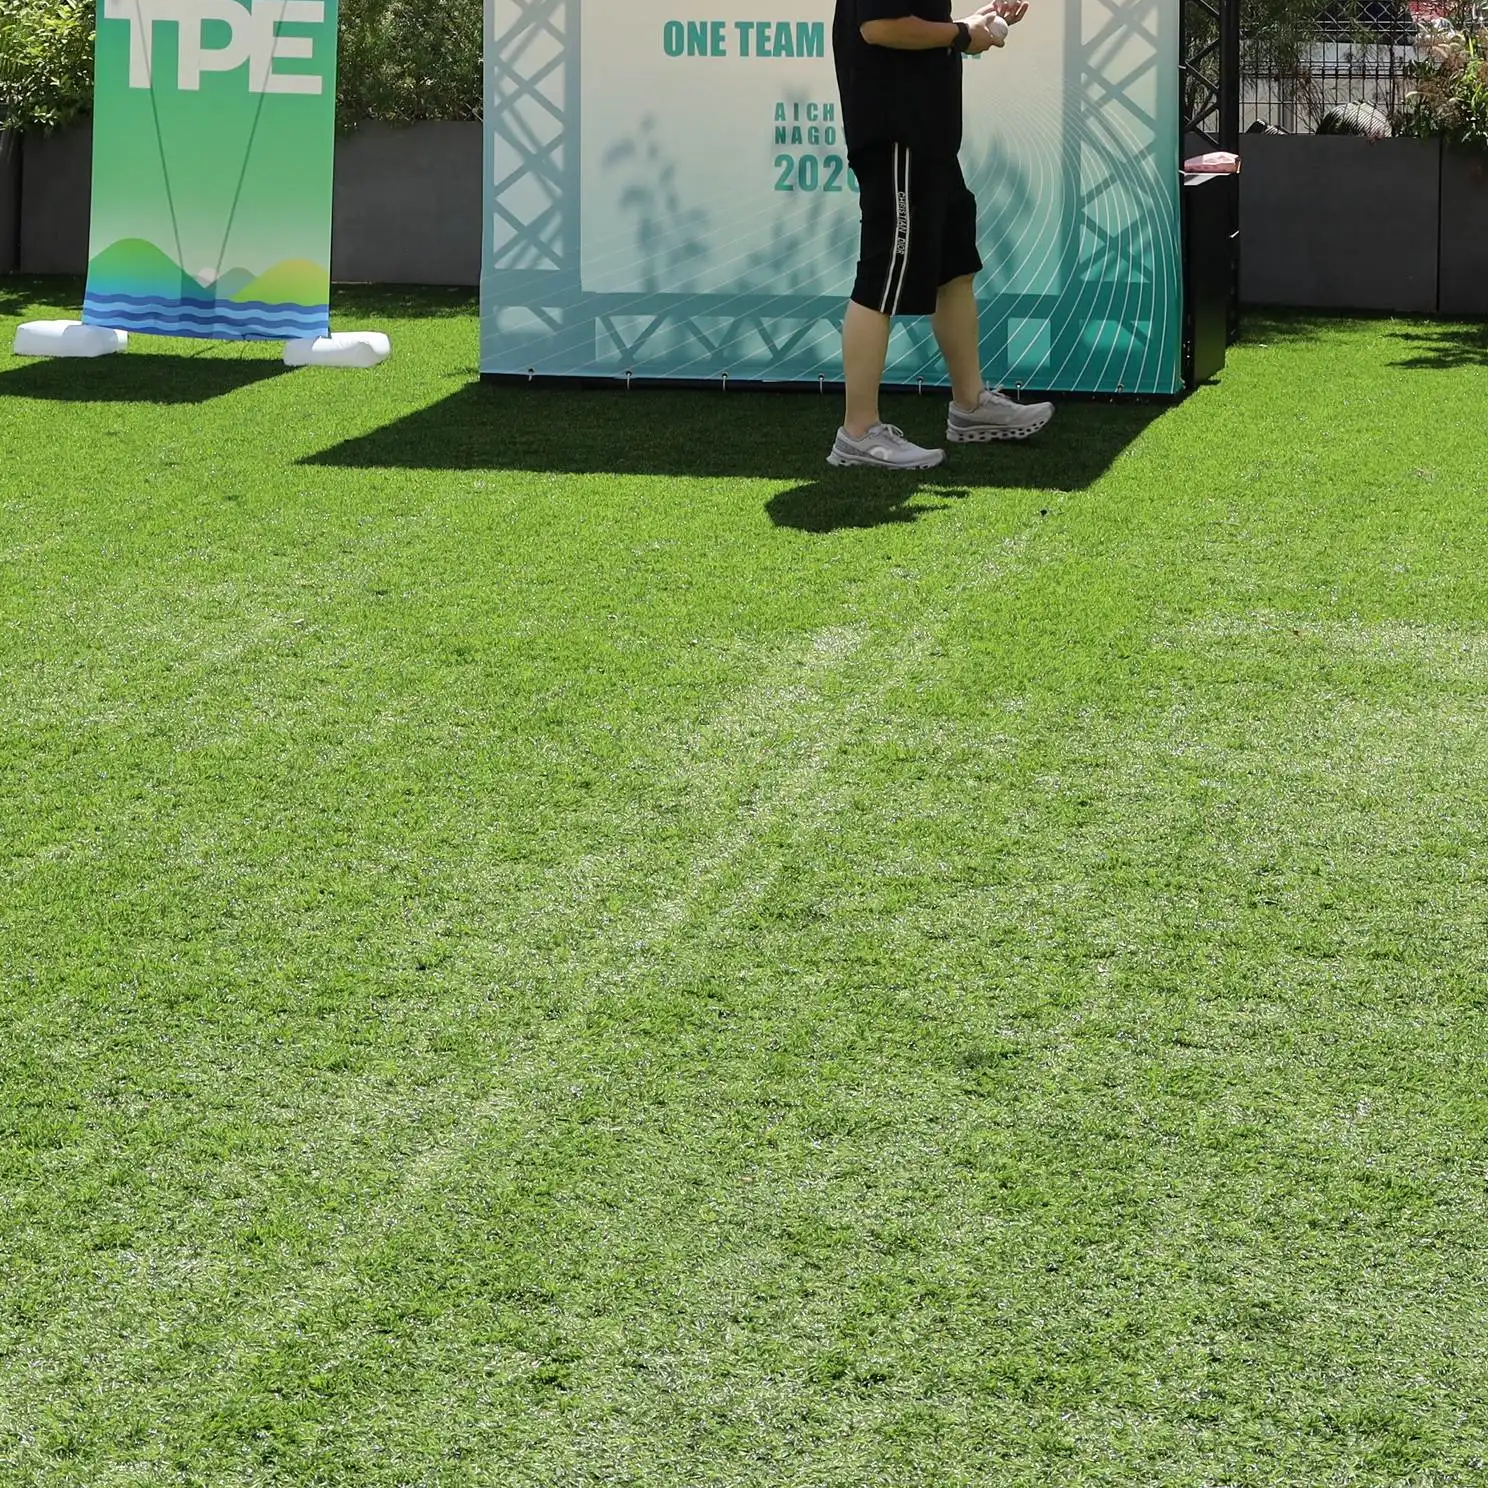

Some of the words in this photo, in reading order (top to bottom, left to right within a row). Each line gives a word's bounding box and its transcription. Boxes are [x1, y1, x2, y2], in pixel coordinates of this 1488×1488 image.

[663, 20, 727, 58] ONE
[734, 21, 825, 58] TEAM
[775, 102, 836, 122] AICH
[775, 125, 837, 146] NAGO
